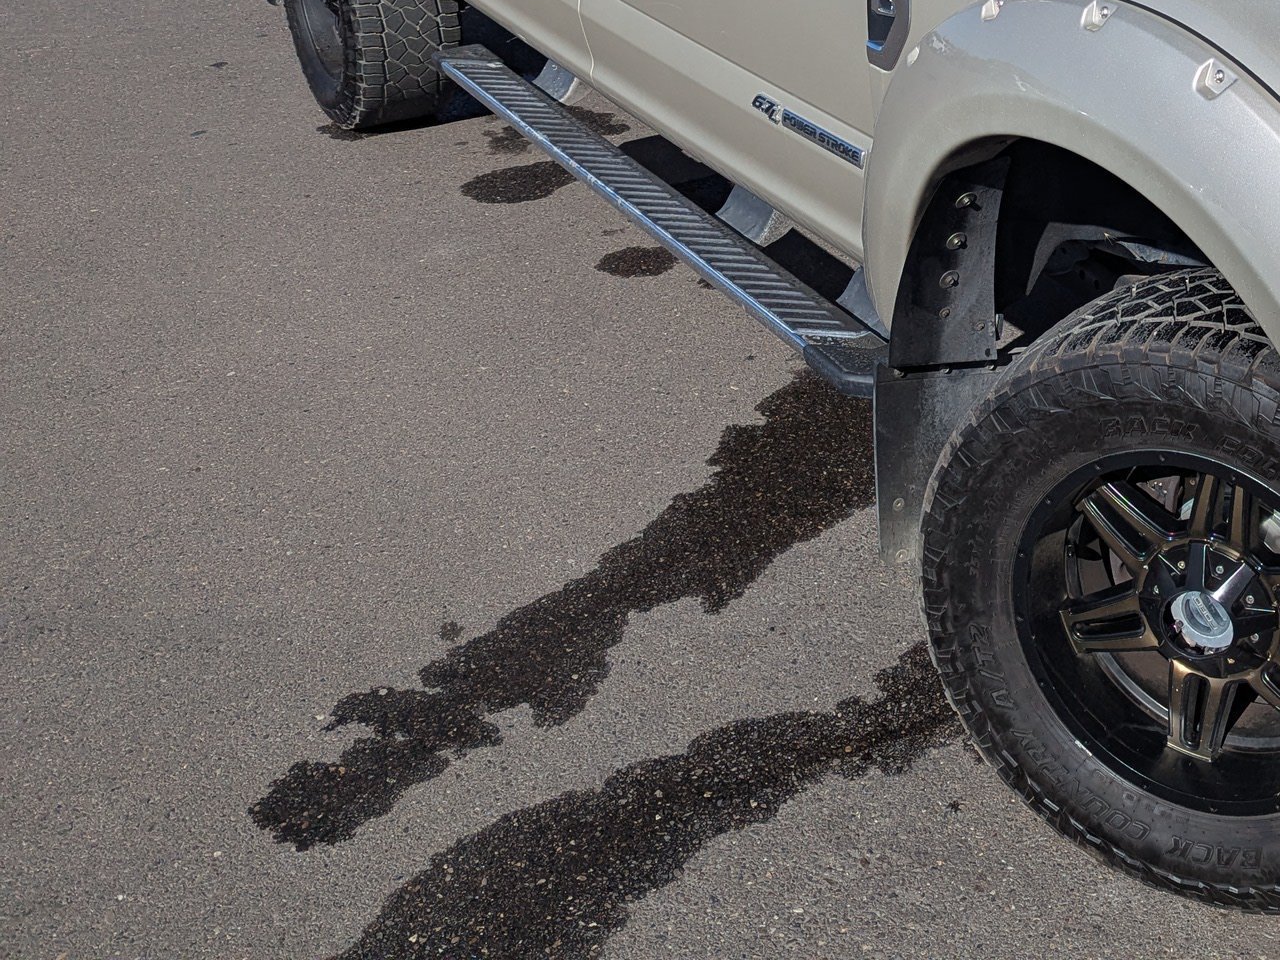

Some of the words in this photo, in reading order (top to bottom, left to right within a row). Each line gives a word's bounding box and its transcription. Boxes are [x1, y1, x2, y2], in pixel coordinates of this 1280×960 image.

[783, 112, 817, 139] POWER
[818, 131, 859, 162] STROKE
[1010, 727, 1151, 842] COUNTRY
[1164, 835, 1264, 870] BACK
